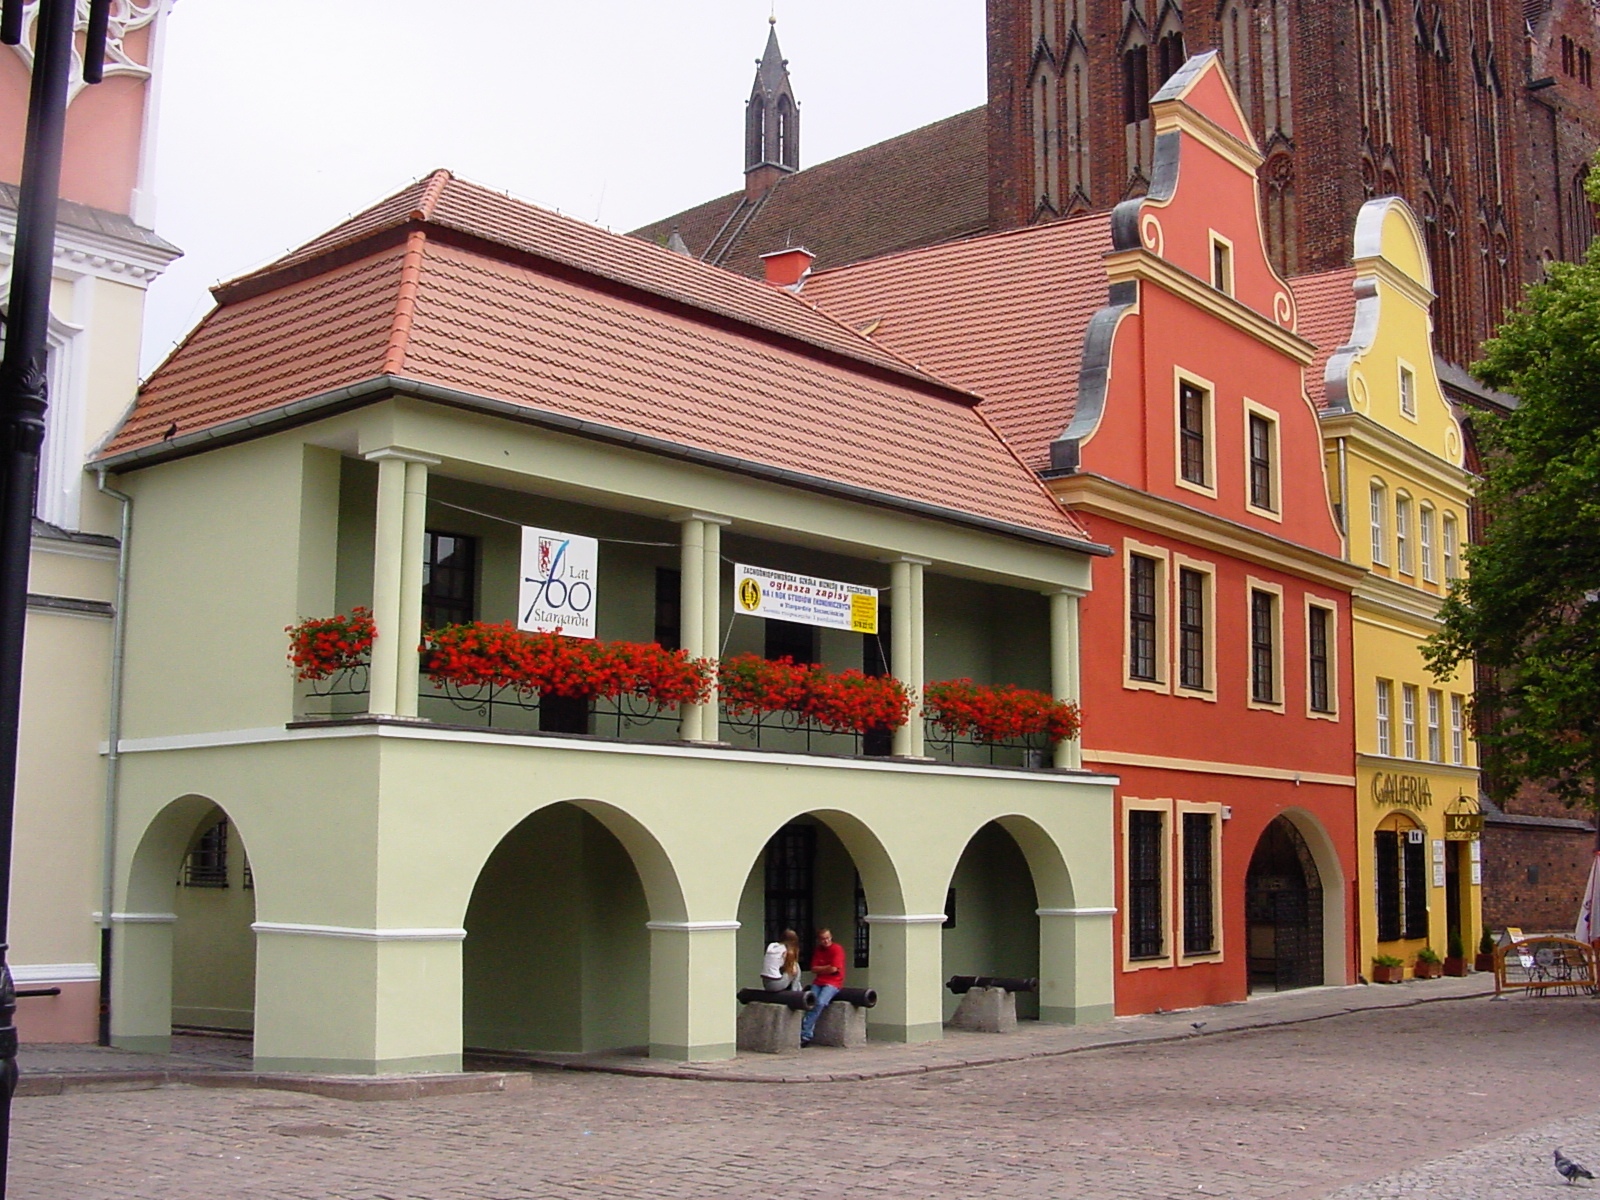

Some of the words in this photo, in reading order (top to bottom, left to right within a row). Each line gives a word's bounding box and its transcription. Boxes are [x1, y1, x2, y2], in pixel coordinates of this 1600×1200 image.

[524, 539, 592, 624] 760
[569, 565, 590, 580] Lat
[762, 589, 770, 597] NA
[775, 592, 786, 600] ROK
[769, 581, 811, 594] ogłasza
[815, 588, 850, 602] zapisy
[534, 608, 590, 627] Stargardu
[1373, 771, 1433, 811] GALERIA
